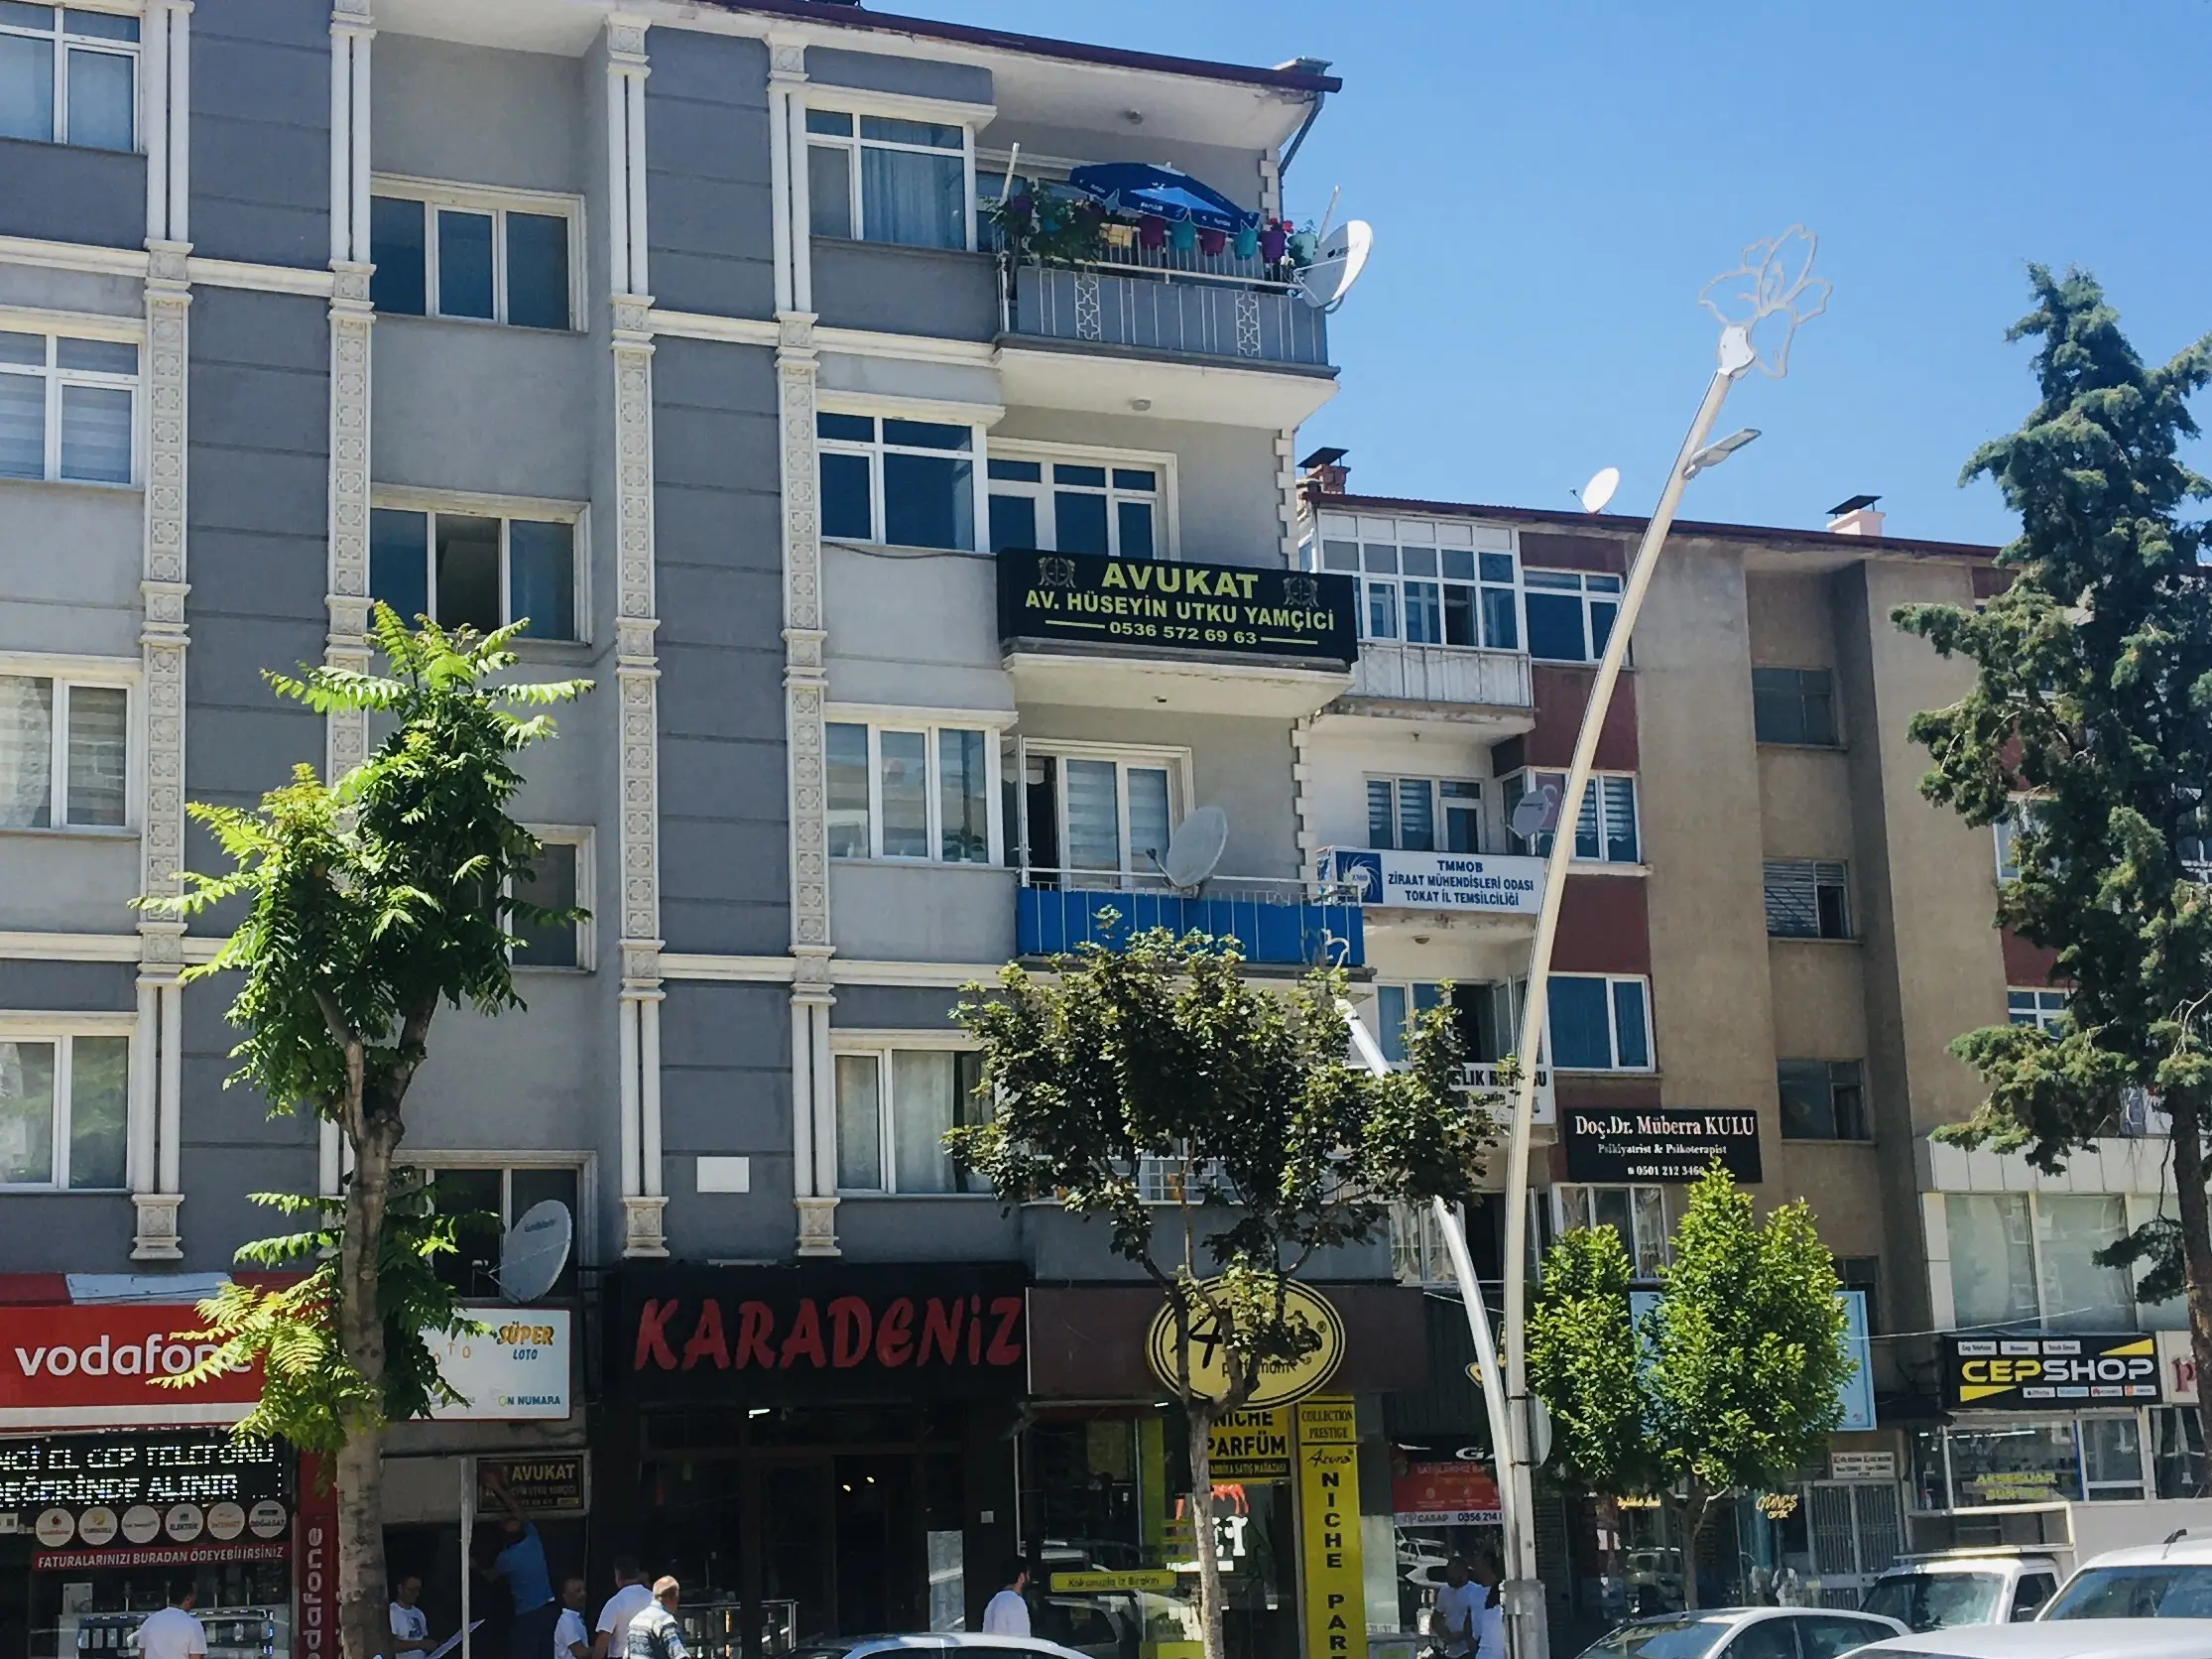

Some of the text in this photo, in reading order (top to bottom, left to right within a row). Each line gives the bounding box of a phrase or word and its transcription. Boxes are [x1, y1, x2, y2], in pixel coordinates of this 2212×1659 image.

[1101, 562, 1259, 599] AVUKAT
[1025, 589, 1334, 632] AV. HÜSEYİN UTKU YAMÇİCİ
[1110, 621, 1258, 645] 0536 572 69 63
[1436, 859, 1483, 873] TMMOB
[1388, 871, 1535, 891] ZİRAAT MÜHENDİSLERİ ODASI
[1405, 888, 1520, 906] TOKAT İL TEMSİLCİLİĞİ
[1637, 1115, 1701, 1135] Müberra
[1704, 1115, 1755, 1136] KULU
[1597, 1143, 1727, 1158] Psikiyatrist & Psikoterapist
[1637, 1165, 1659, 1176] 0501
[1661, 1165, 1679, 1176] 212
[497, 1321, 555, 1346] SÜPER
[512, 1348, 539, 1360] LOTO
[517, 1395, 561, 1406] NUMARA
[1301, 1409, 1353, 1422] COLLECTION
[1309, 1427, 1348, 1439] PRESTIGE
[512, 1464, 575, 1480] AVUKAT
[1457, 1512, 1482, 1523] 0356
[38, 1544, 284, 1569] FATURALARINIZI BURADAN ÖDEYEBİLİRSİNİZ
[1321, 1472, 1348, 1659] NICHE PAR
